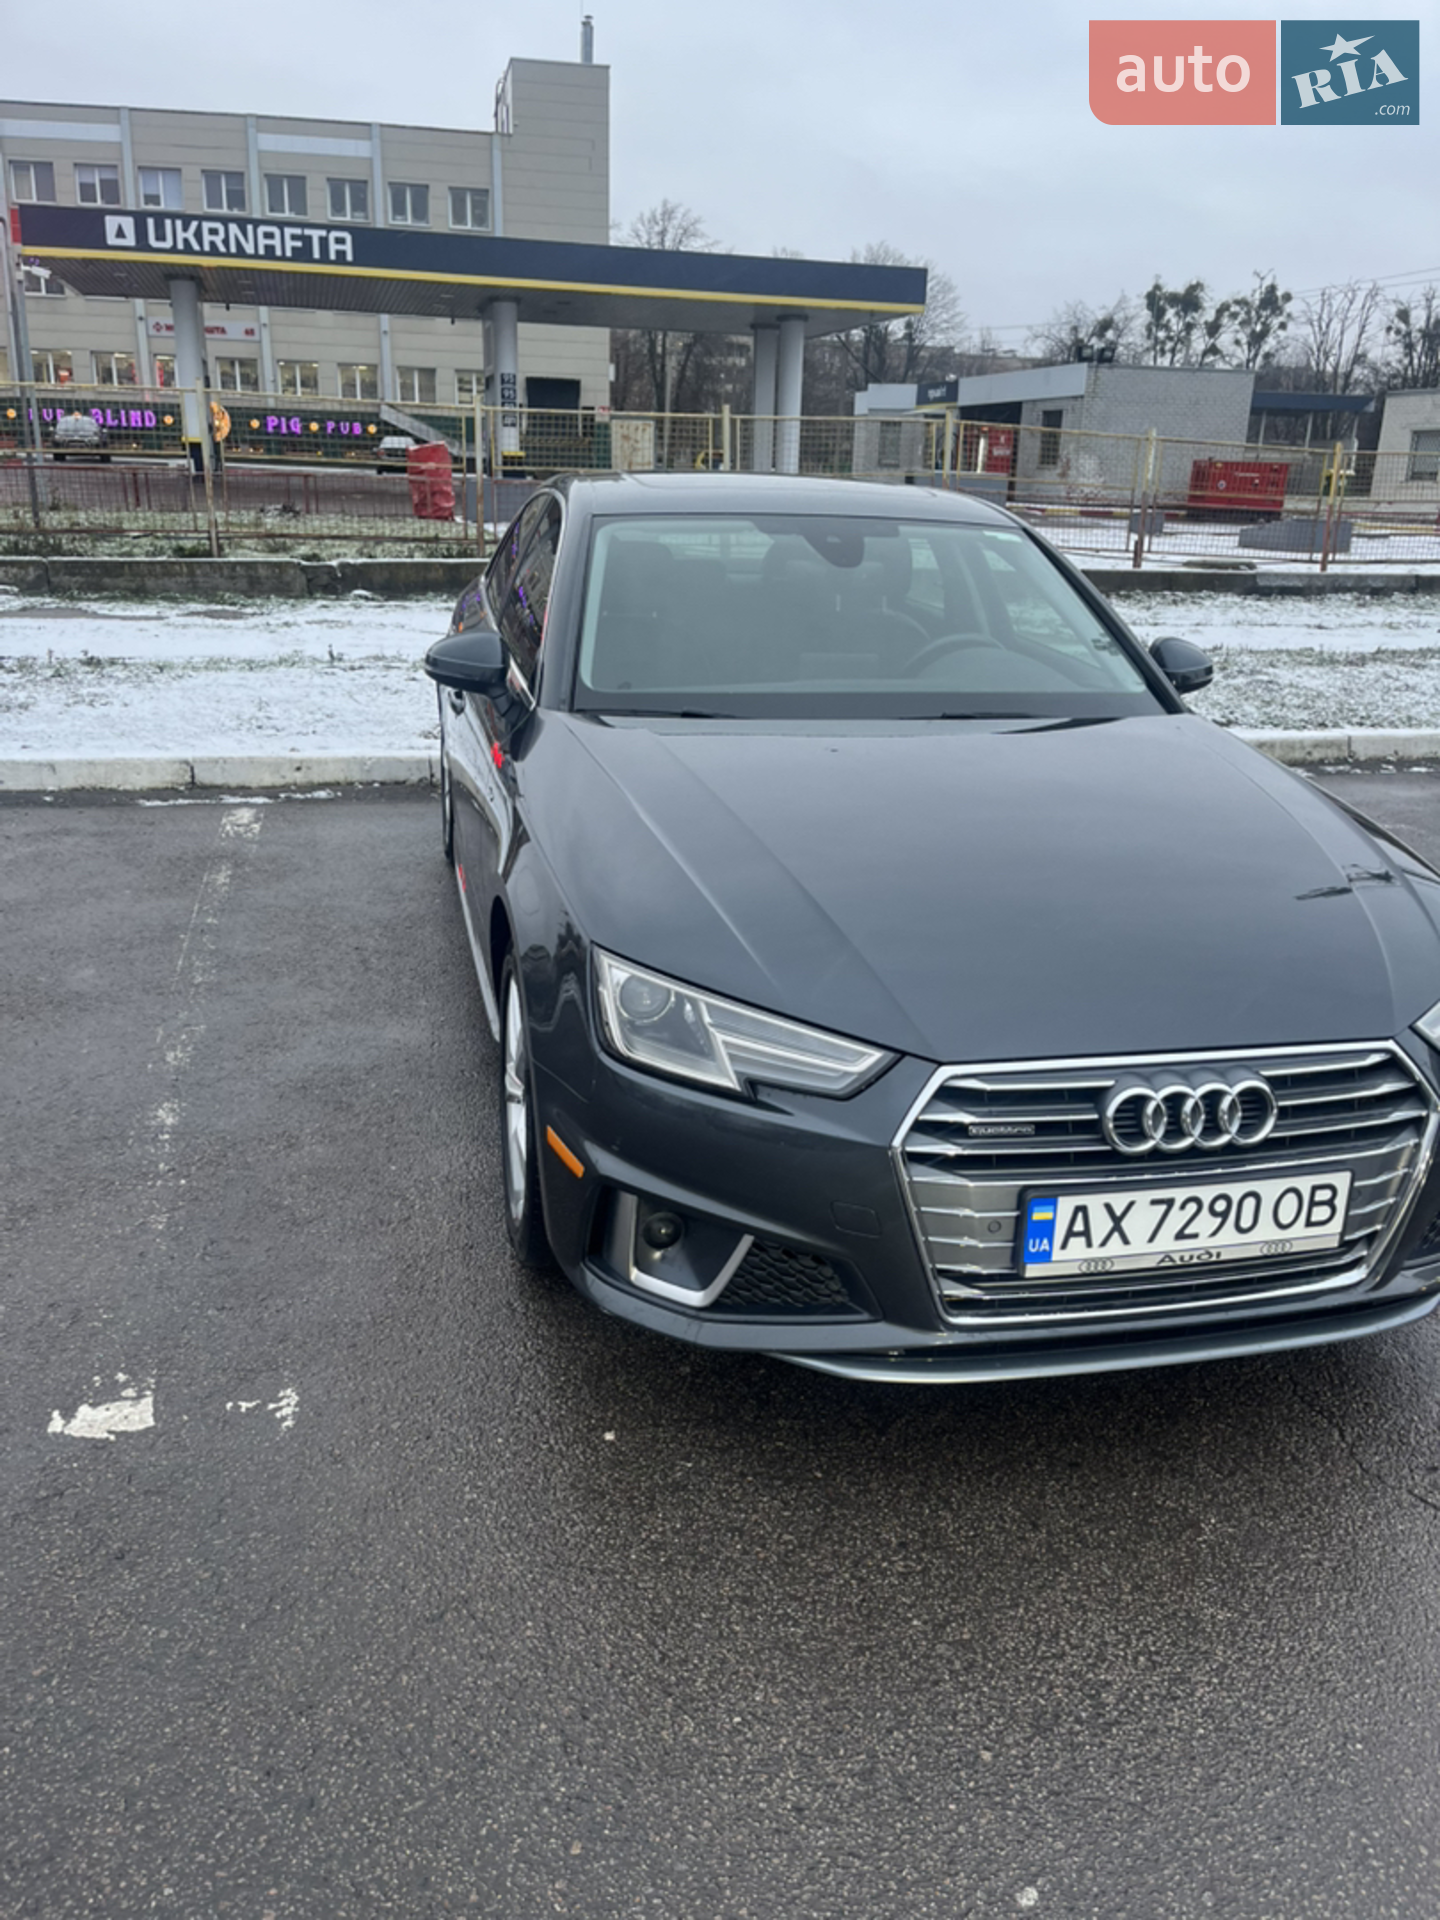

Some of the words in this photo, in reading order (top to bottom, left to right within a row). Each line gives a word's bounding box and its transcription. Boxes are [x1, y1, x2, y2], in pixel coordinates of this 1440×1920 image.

[147, 217, 353, 262] UKRNAFTA
[90, 408, 157, 428] BLIND
[266, 415, 302, 435] PIG
[326, 421, 362, 435] PUB
[1059, 1199, 1137, 1251] AX
[1146, 1189, 1262, 1244] 7290
[1272, 1183, 1338, 1231] OB
[1028, 1237, 1051, 1253] UA
[1156, 1249, 1222, 1267] Audi
